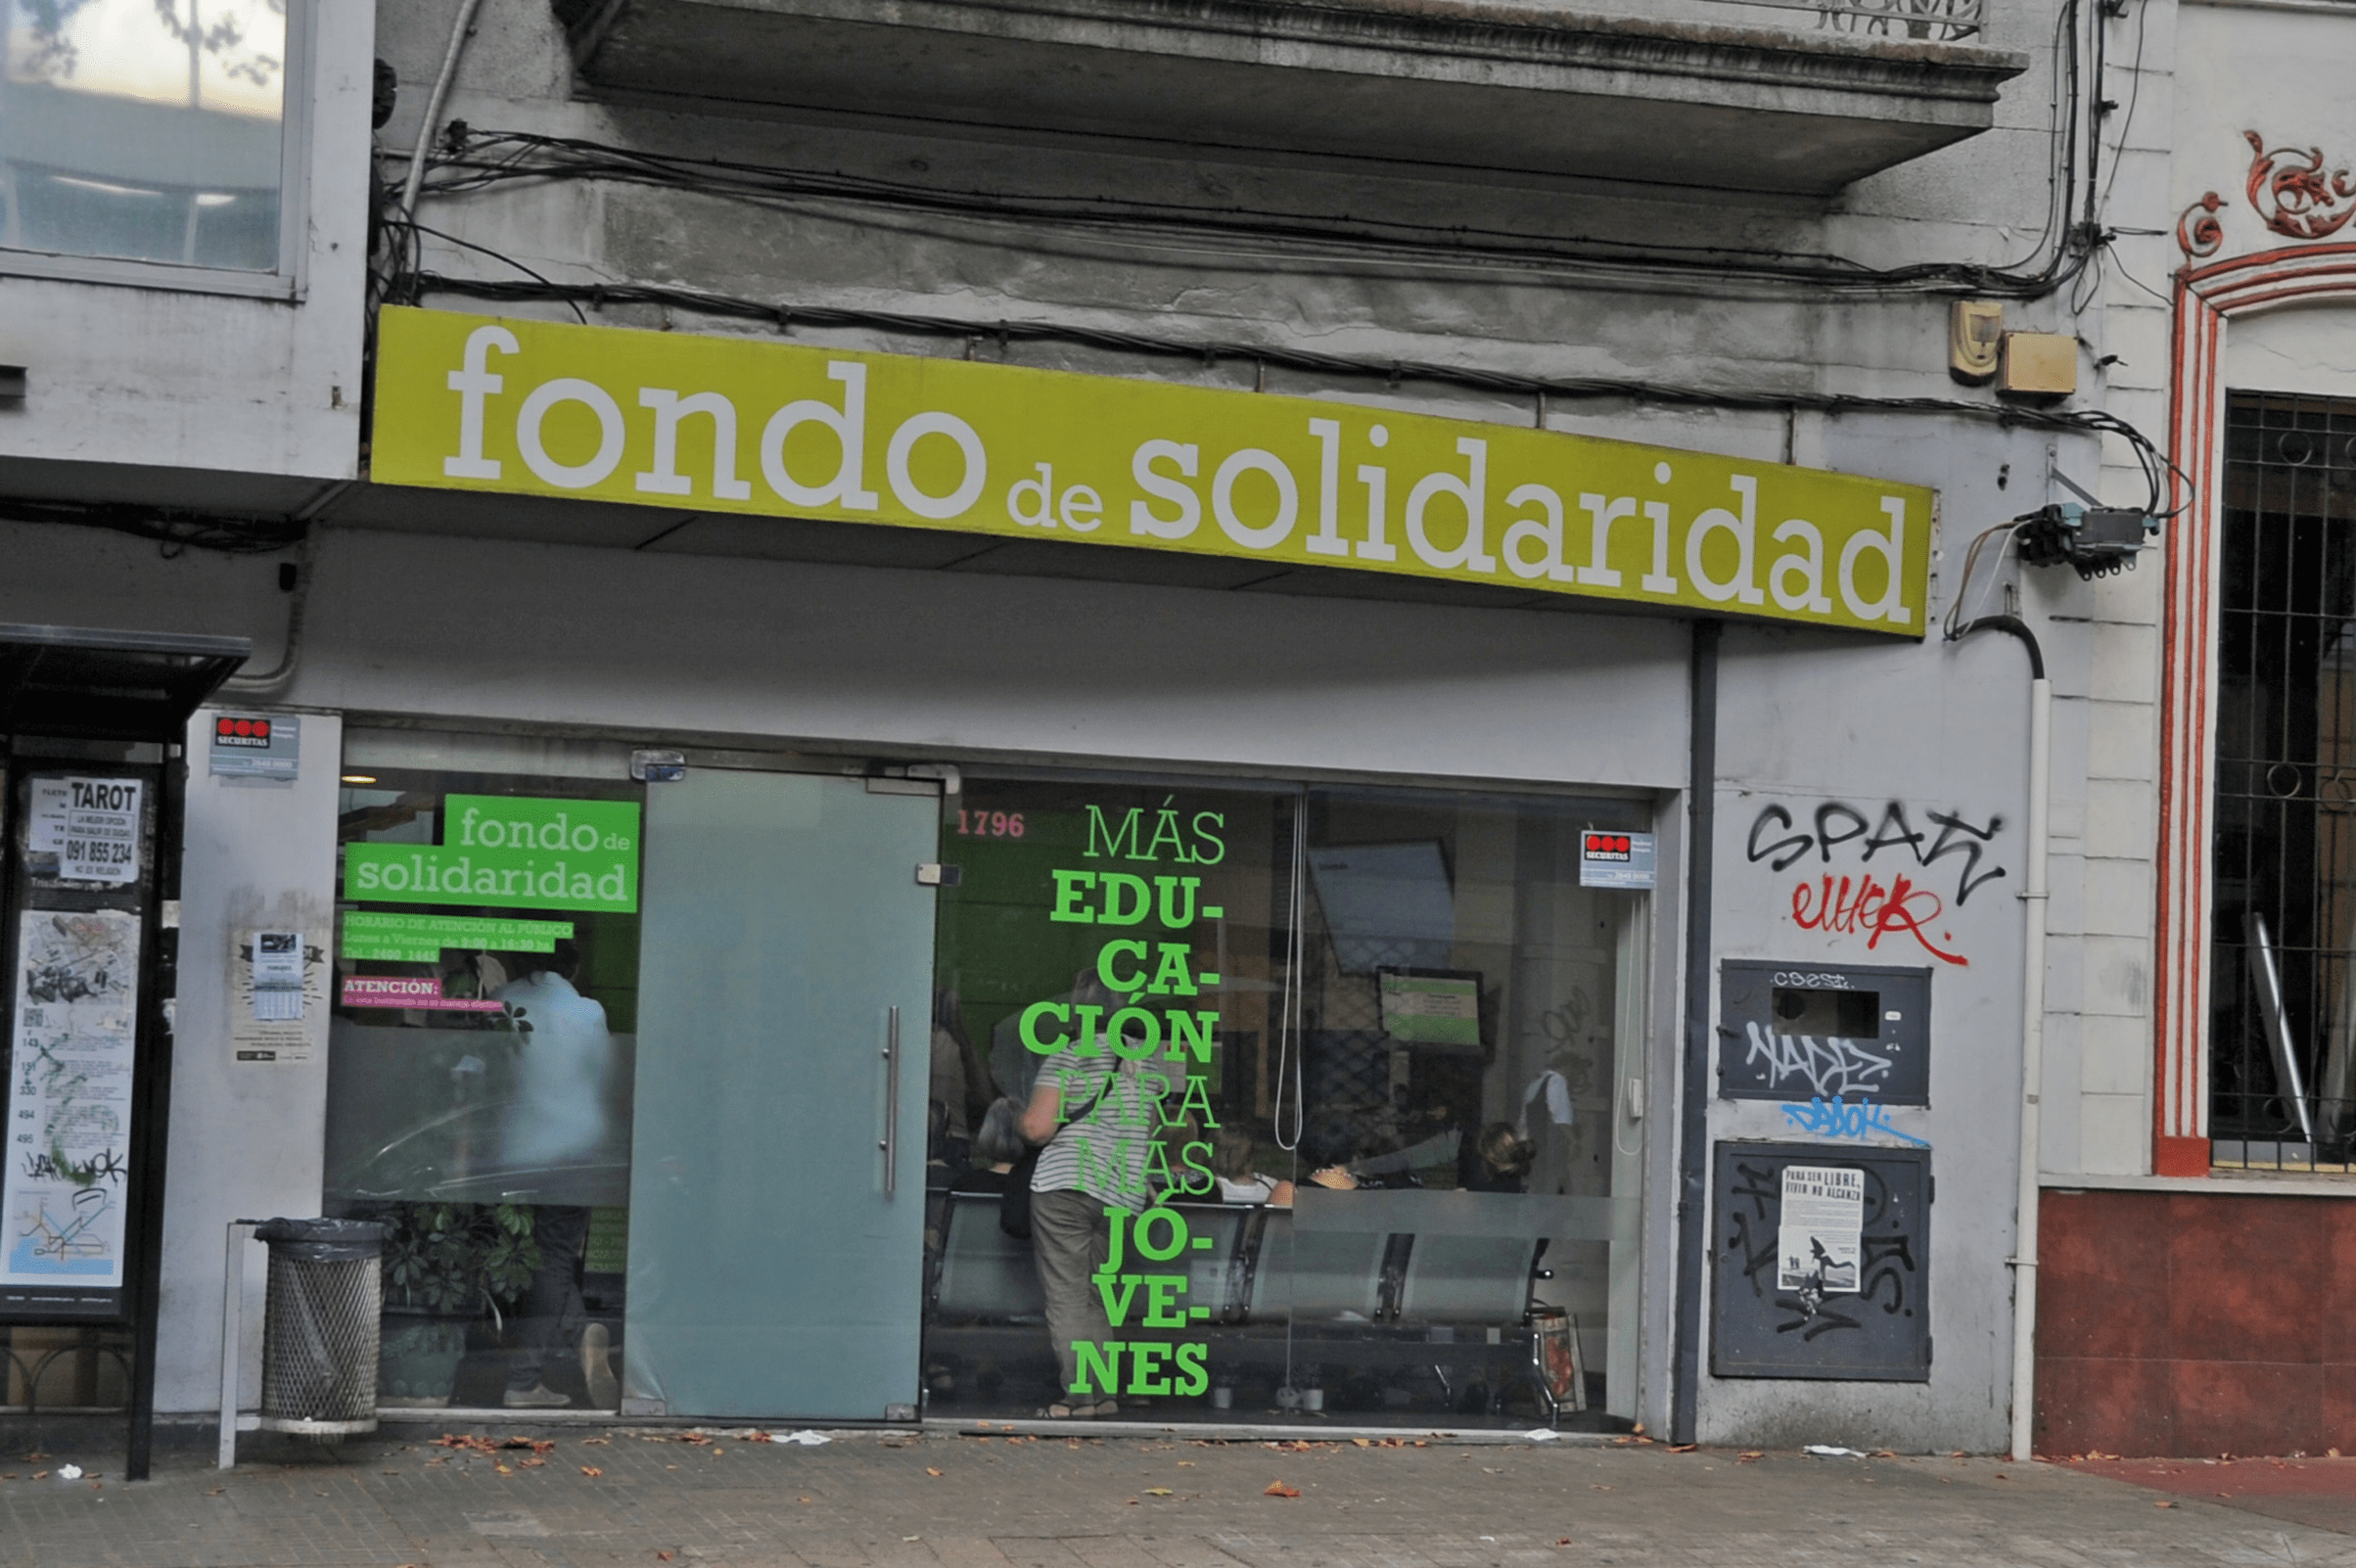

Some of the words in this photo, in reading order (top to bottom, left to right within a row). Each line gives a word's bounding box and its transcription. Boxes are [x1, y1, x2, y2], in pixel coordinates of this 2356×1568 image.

[443, 325, 987, 519] fondo
[1005, 462, 1104, 531] de
[1129, 417, 1912, 623] solidaridad
[217, 736, 268, 746] SECURITAS
[71, 782, 136, 811] TAROT
[459, 807, 600, 852] fondo
[603, 832, 631, 851] de
[957, 808, 1025, 837] 1796
[1083, 795, 1224, 865] MÁS
[67, 840, 86, 861] 091
[89, 841, 110, 862] 855
[113, 843, 132, 864] 234
[1586, 851, 1628, 860] SECURITAS
[356, 853, 628, 900] solidaridad
[1049, 869, 1224, 929] EDU-
[344, 931, 380, 944] Lunes
[391, 933, 439, 946] Viernes
[441, 937, 458, 948] de
[345, 915, 405, 930] HORARIO
[407, 918, 426, 930] DE
[428, 918, 496, 934] ATENCIÓN
[498, 923, 515, 934] AL
[517, 922, 573, 937] PÚBLICO
[1097, 939, 1221, 996] CA-
[344, 979, 439, 994] ATENCIÓN:
[1019, 992, 1221, 1063] CIÓN
[18, 1110, 35, 1120] 494
[1053, 1069, 1222, 1129] PARA
[17, 1133, 33, 1144] 495
[1074, 1126, 1215, 1195] MÁS
[1785, 1171, 1805, 1180] PARA
[1807, 1172, 1823, 1181] SER
[1785, 1182, 1808, 1193] VIVIR
[1812, 1184, 1823, 1196] NO
[1826, 1186, 1861, 1201] ALCANZA
[1098, 1189, 1214, 1274] JÓ-
[1091, 1273, 1211, 1328] VE-
[1069, 1340, 1209, 1397] NES
